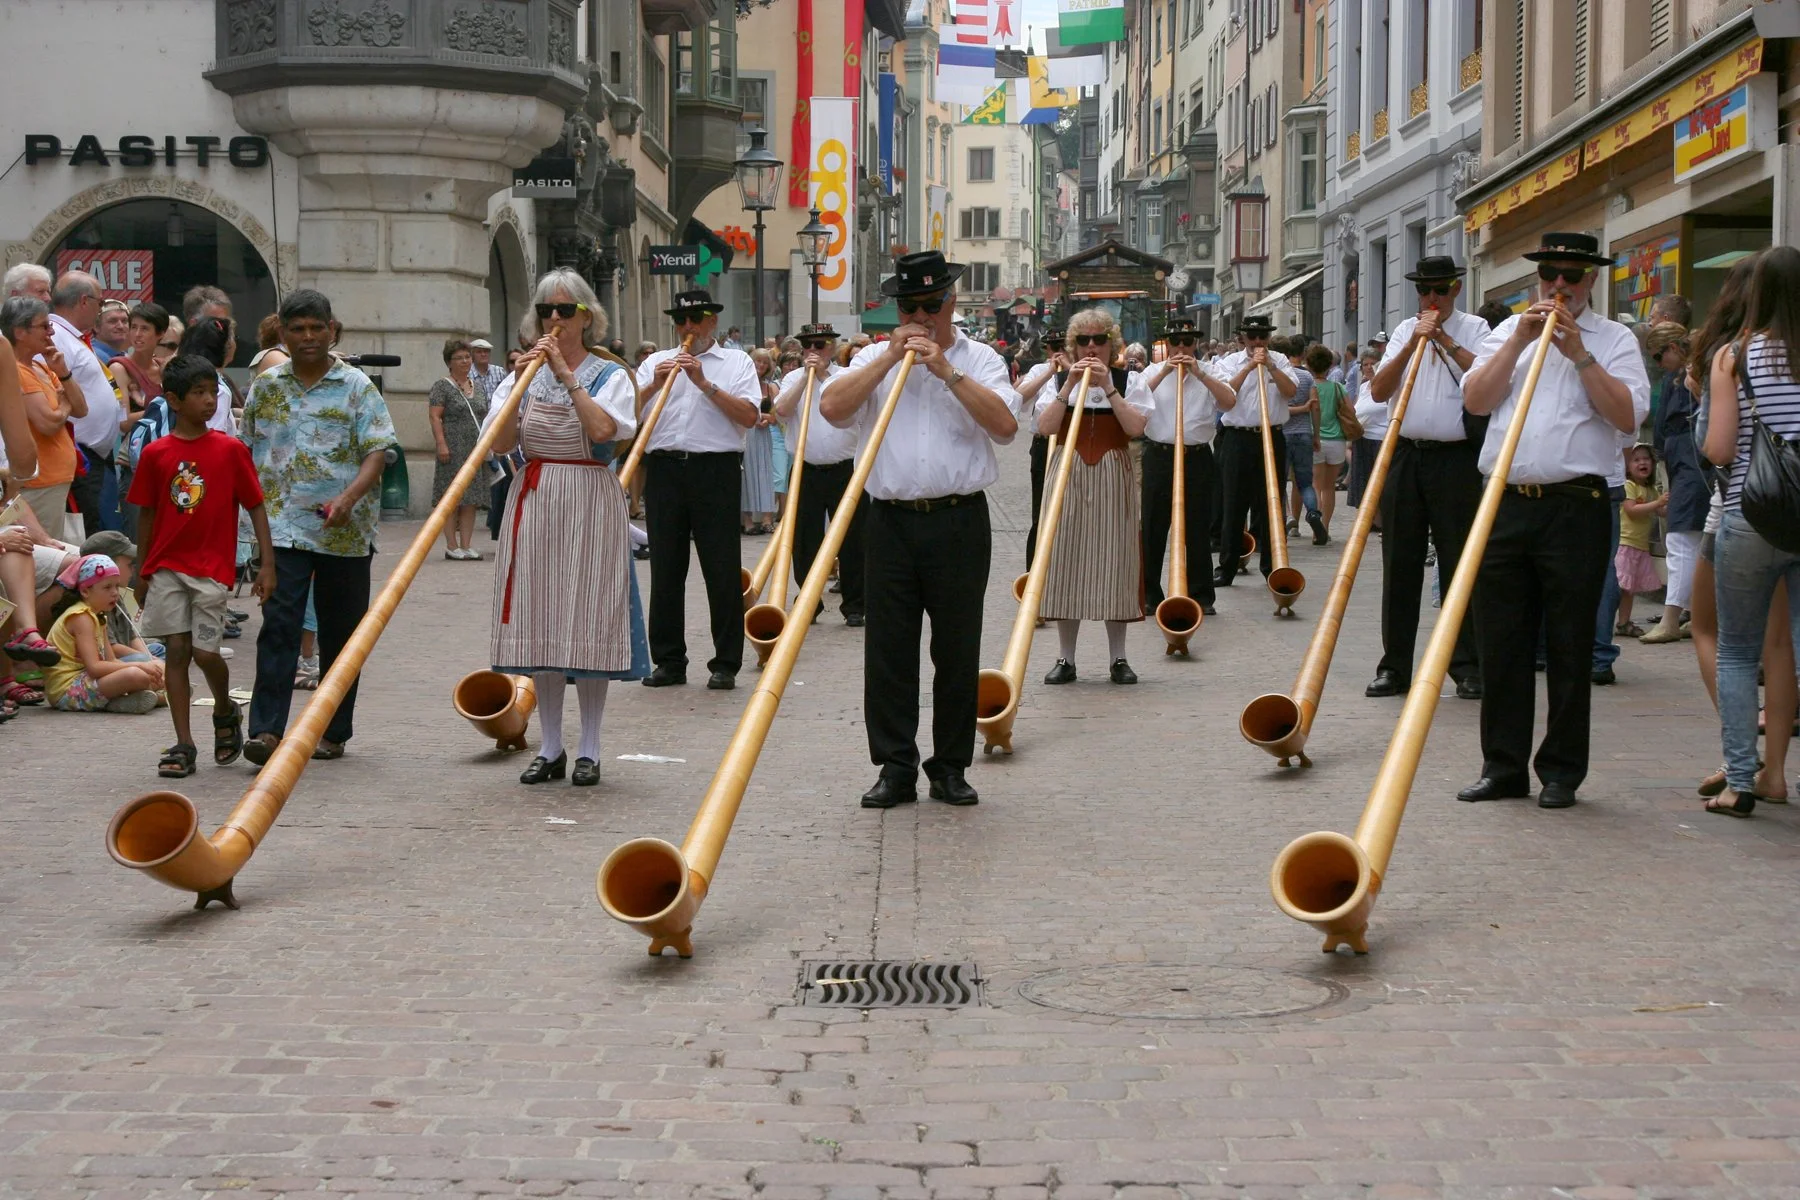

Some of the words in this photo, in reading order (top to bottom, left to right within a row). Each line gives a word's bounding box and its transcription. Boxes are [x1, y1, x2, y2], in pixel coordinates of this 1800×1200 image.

[25, 134, 269, 167] PASITO
[515, 179, 572, 188] PASITO
[659, 253, 696, 266] Yendi
